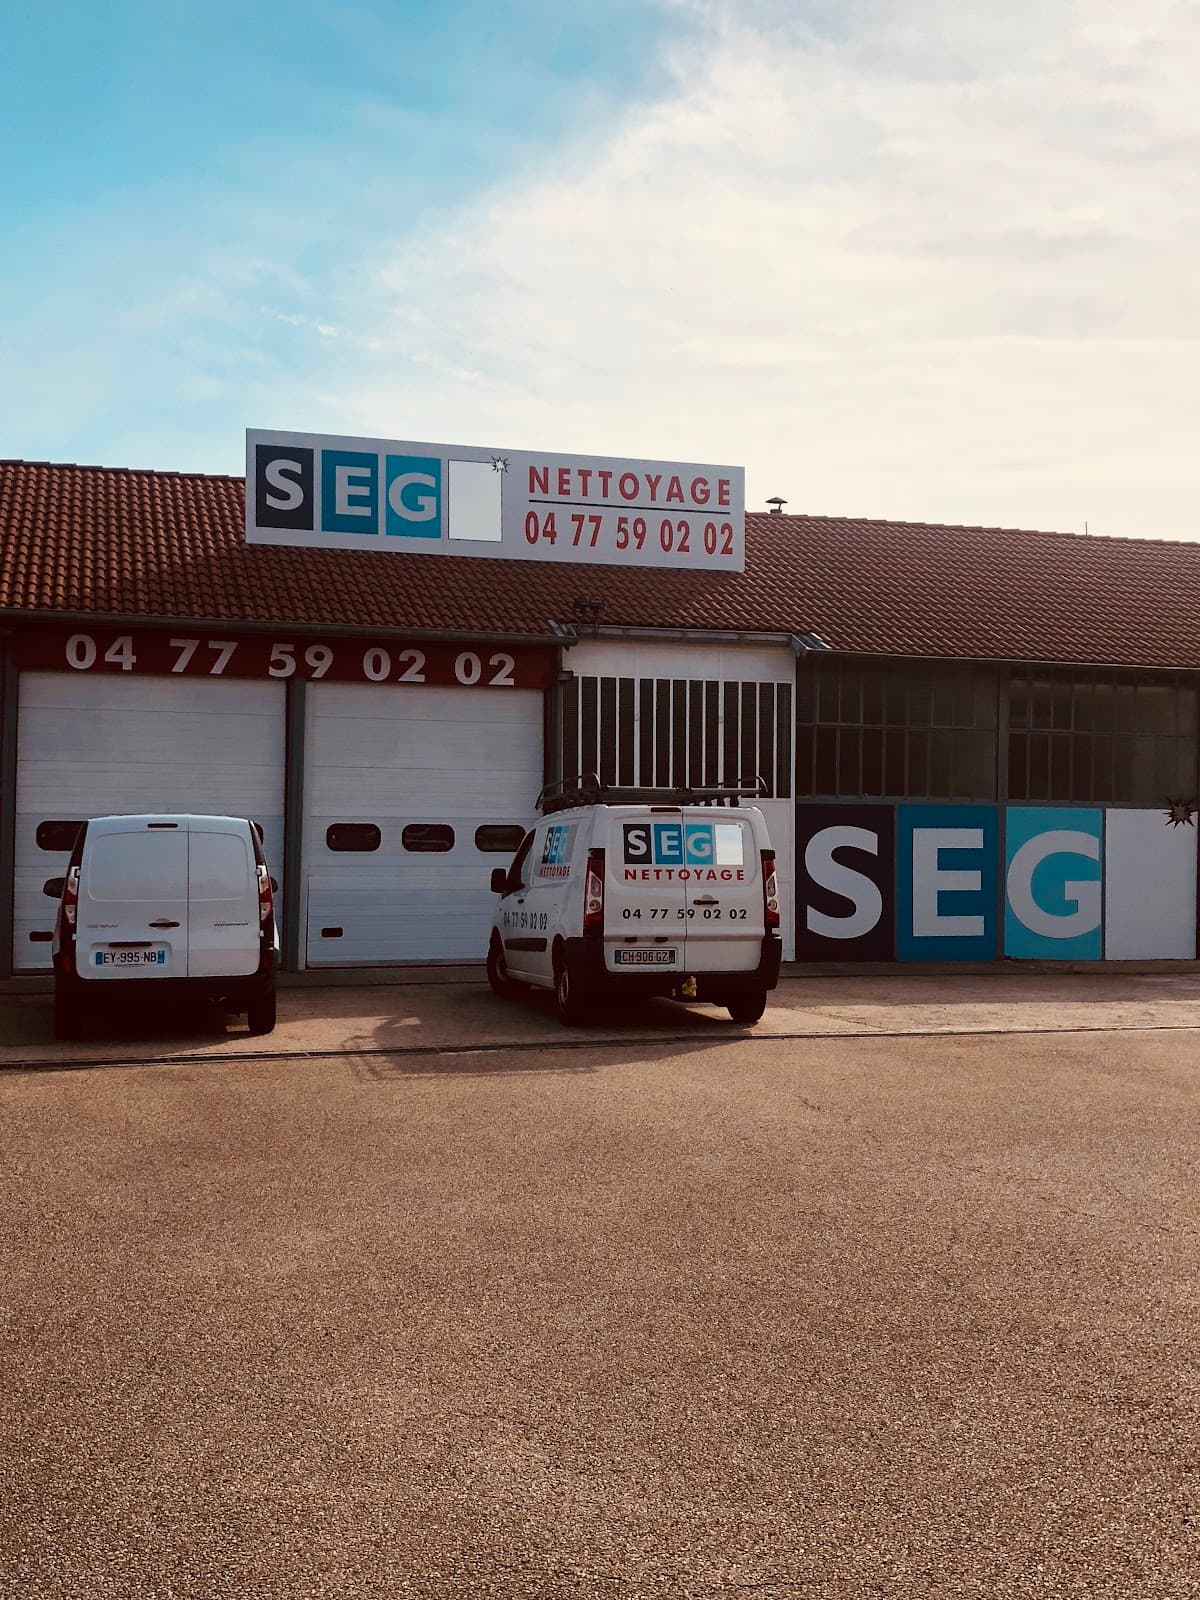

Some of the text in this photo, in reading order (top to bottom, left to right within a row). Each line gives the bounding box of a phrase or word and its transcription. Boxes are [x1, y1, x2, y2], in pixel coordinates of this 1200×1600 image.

[264, 458, 438, 523] SEG
[528, 465, 731, 506] NETTOYAGE
[525, 511, 734, 555] 04 77 59 02 02
[65, 634, 516, 686] 04 77 59 02 02
[627, 829, 713, 857] SEG
[624, 869, 745, 881] NETTOYAGE
[804, 824, 1101, 939] SEG
[512, 911, 519, 927] 77
[530, 912, 538, 930] 02
[539, 913, 548, 930] 02
[622, 908, 747, 919] 04 77 59 02 02
